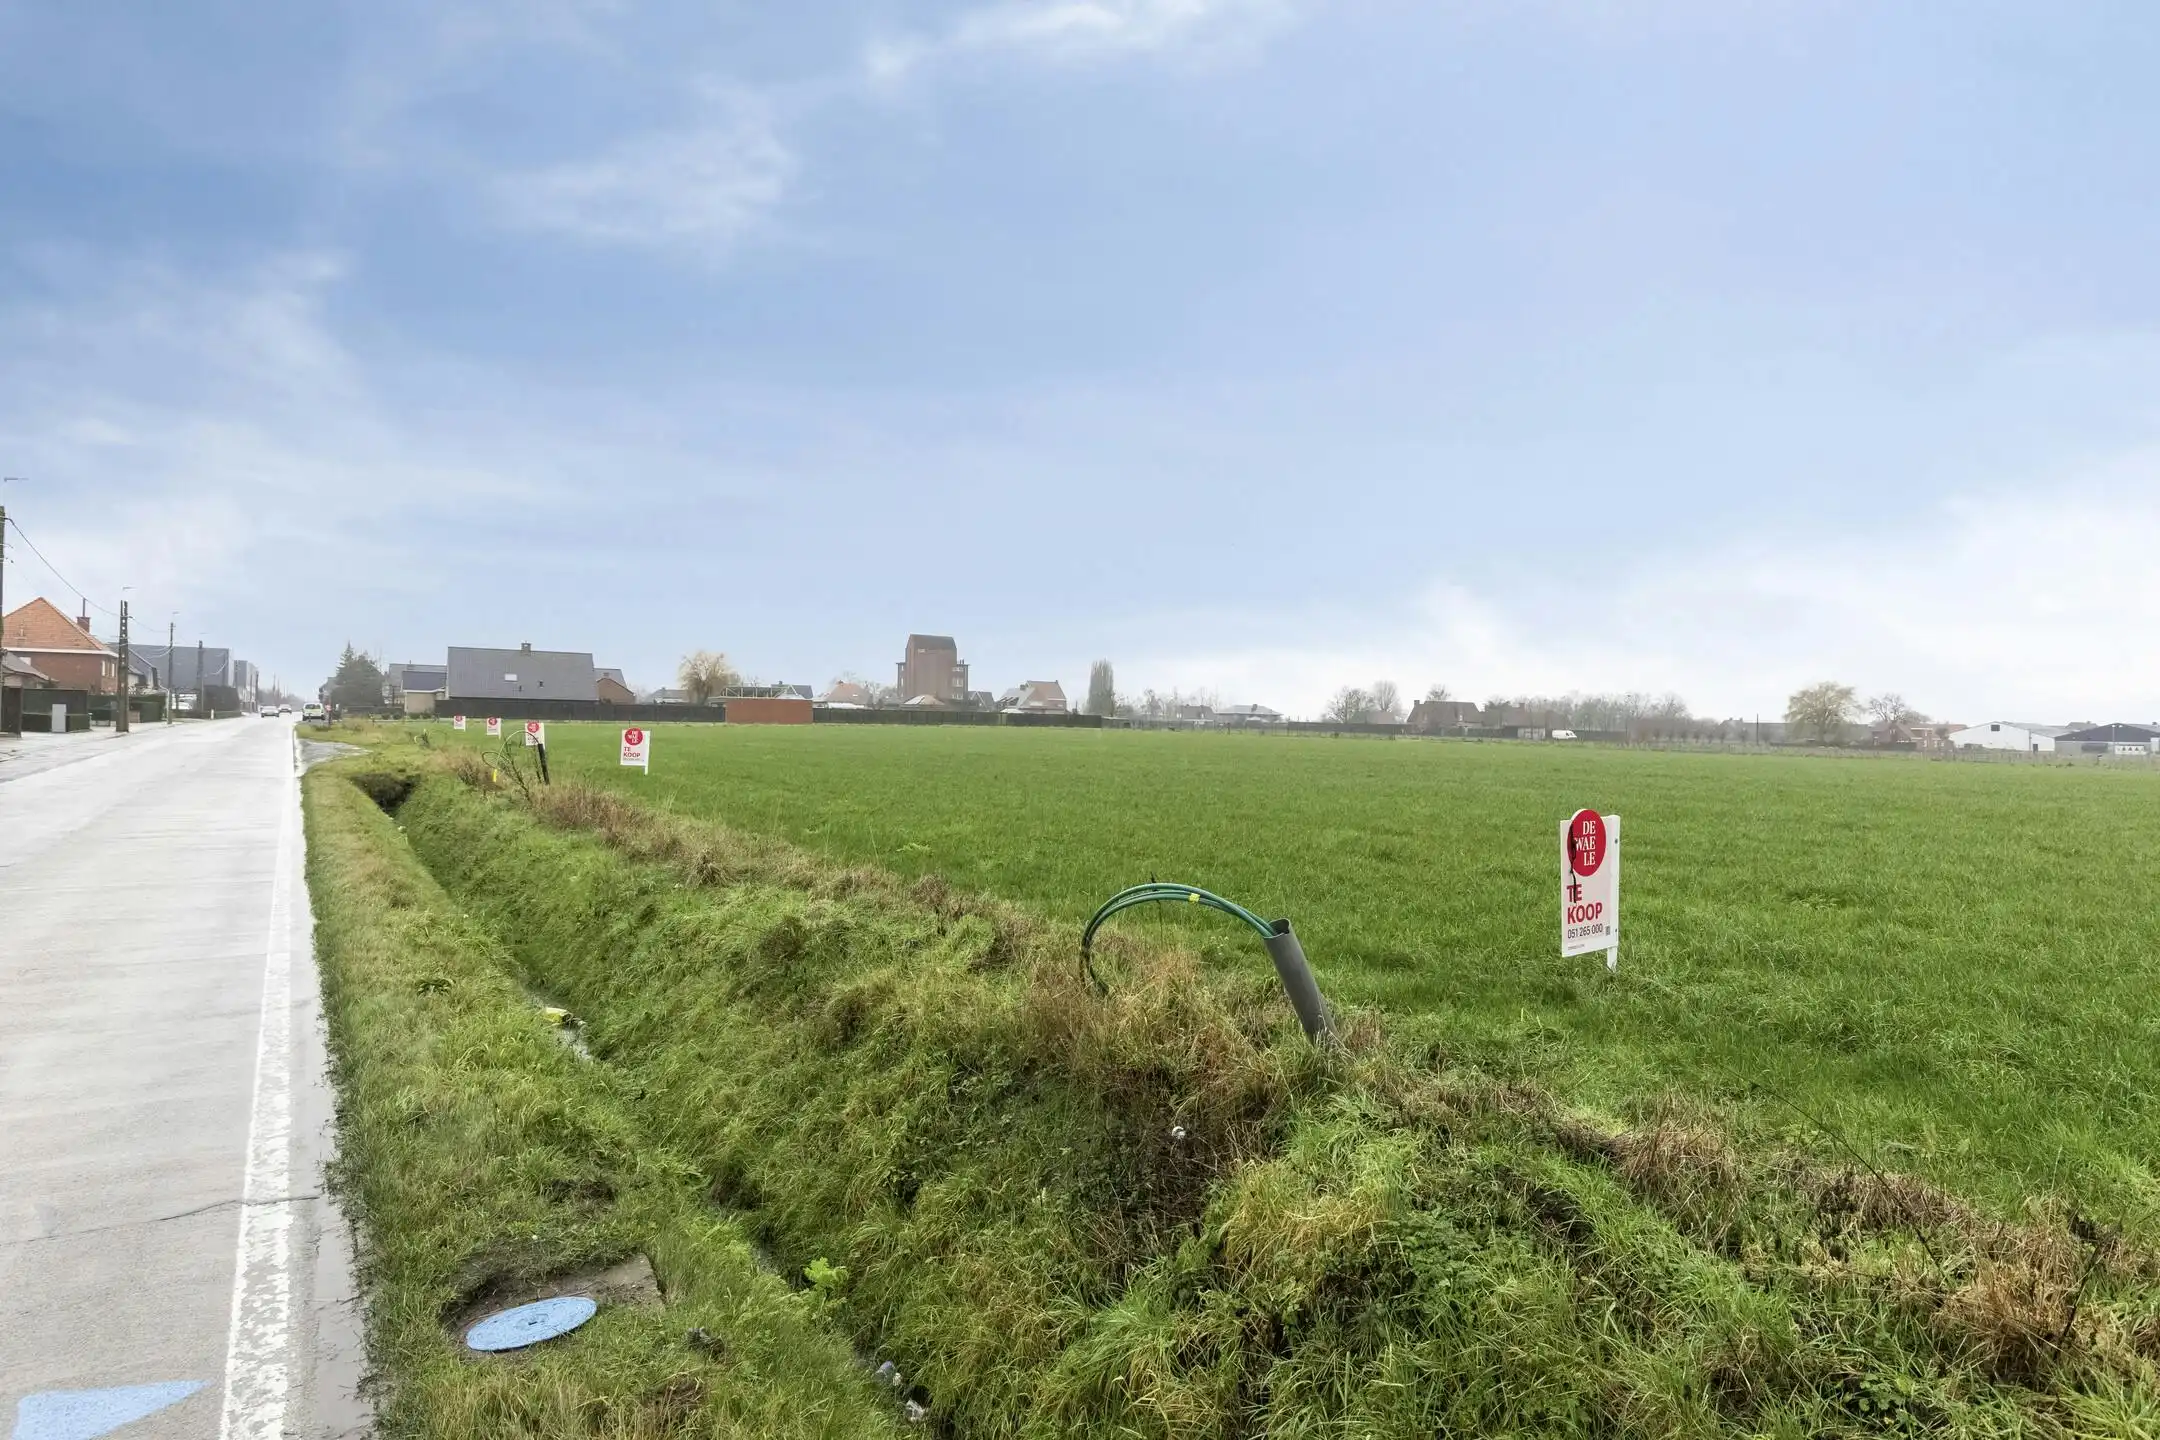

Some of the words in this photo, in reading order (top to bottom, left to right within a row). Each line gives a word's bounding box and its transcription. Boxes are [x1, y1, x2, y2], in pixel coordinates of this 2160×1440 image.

[1583, 821, 1596, 835] DE
[1574, 836, 1596, 851] WAE
[1584, 852, 1596, 866] LE
[1567, 884, 1582, 902] TE
[1567, 902, 1603, 924] KOOP
[1567, 928, 1578, 939] 051
[1580, 926, 1591, 936] 265
[1591, 923, 1603, 934] 000
